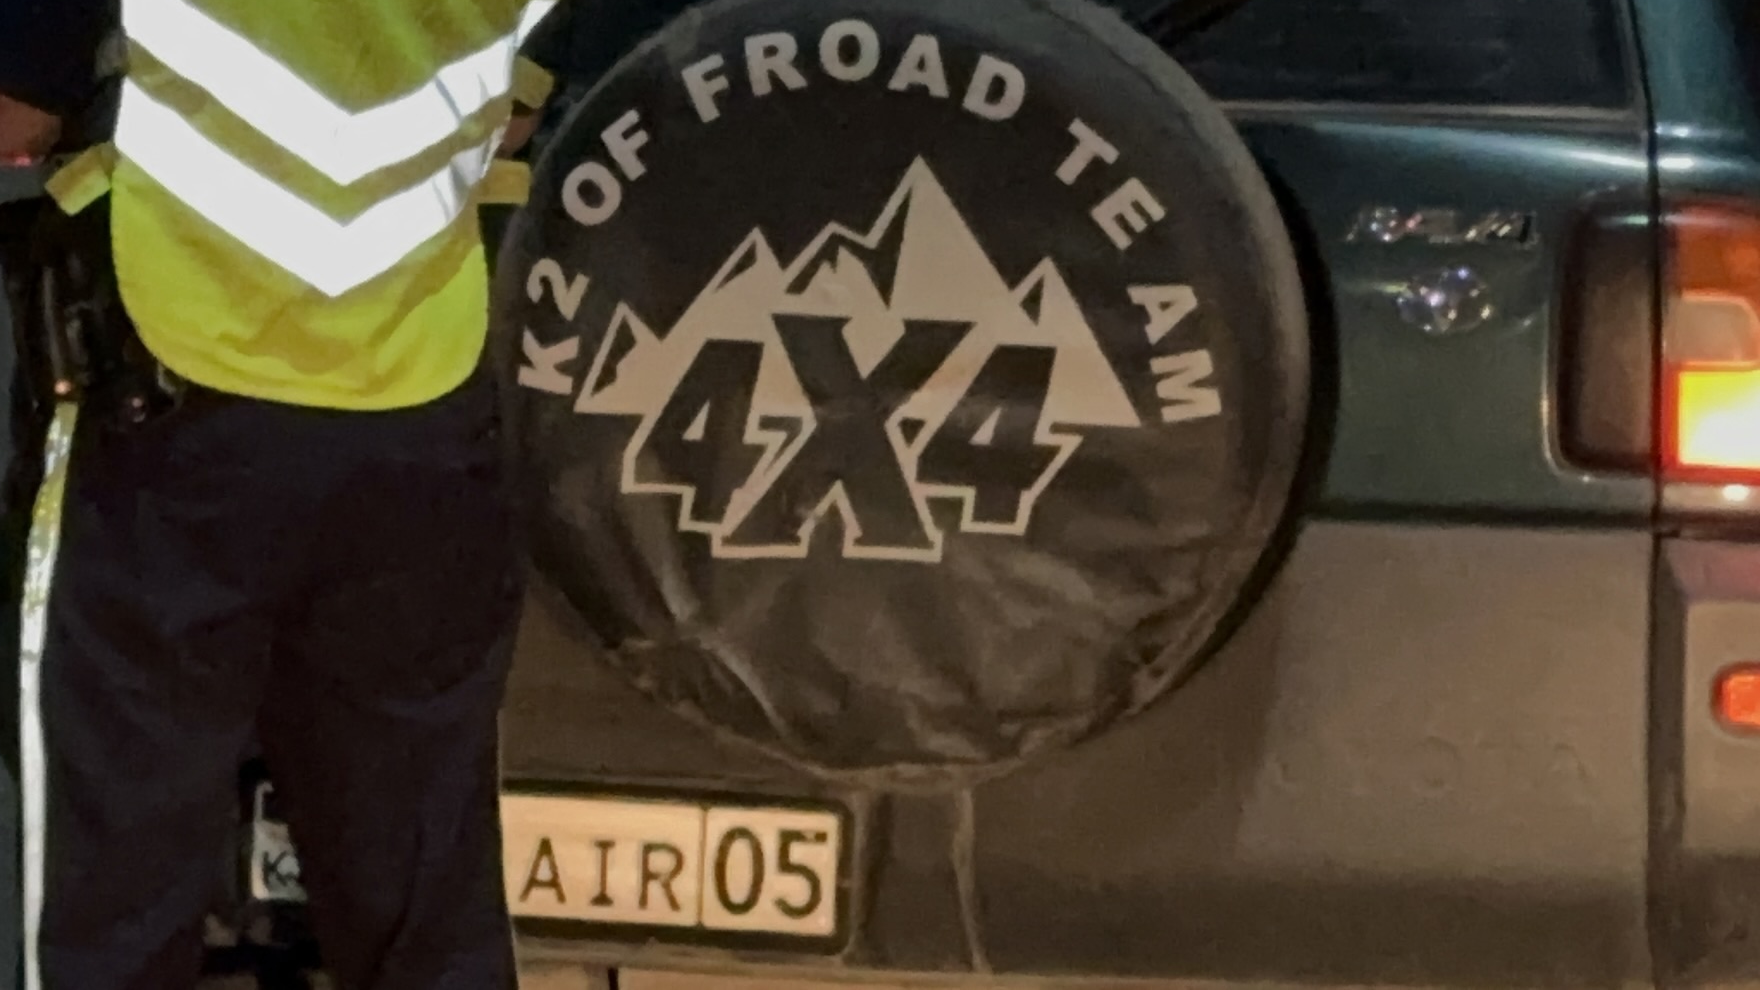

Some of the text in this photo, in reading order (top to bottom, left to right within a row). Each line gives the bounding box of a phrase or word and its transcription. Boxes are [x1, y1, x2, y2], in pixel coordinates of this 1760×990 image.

[517, 257, 590, 396] K2
[1055, 118, 1222, 423] TEAM
[520, 826, 828, 919] AIR 05
